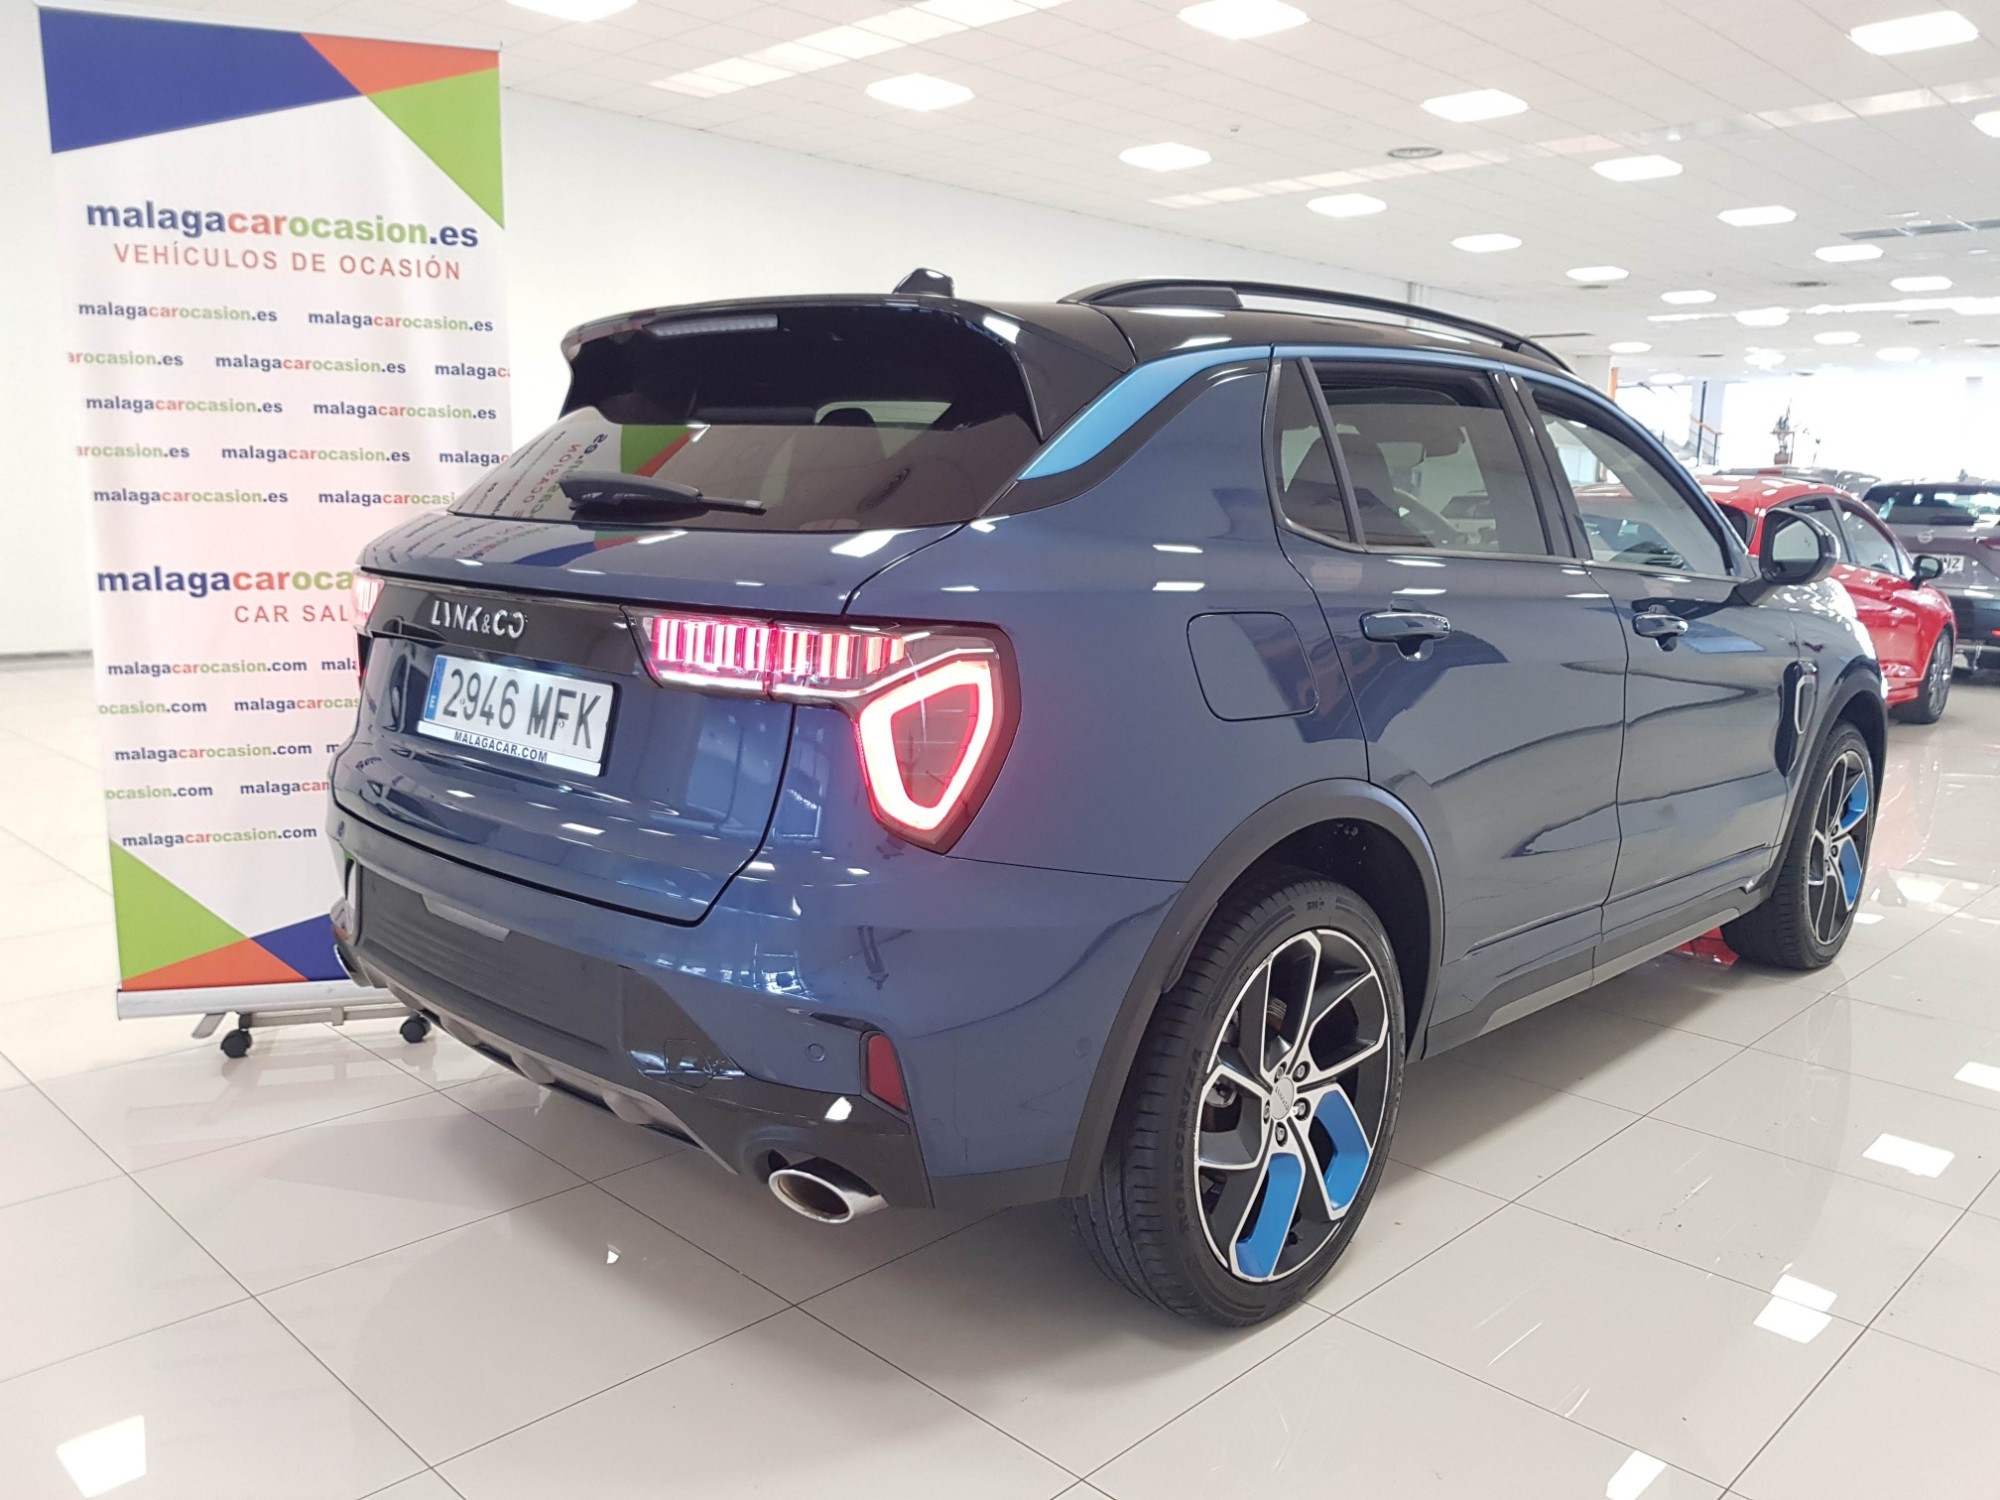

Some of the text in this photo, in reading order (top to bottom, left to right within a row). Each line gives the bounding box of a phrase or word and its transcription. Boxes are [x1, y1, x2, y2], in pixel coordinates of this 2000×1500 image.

[87, 200, 479, 248] malagacarocasion.es
[114, 241, 460, 280] VEHÍCULOS DE OCASIÓN
[78, 301, 278, 322] malagacarocasion.es
[308, 310, 494, 333] malagacarocasion.es
[215, 353, 407, 374] malagacarocasion.es
[86, 395, 284, 414] malagacarocasion.es
[313, 401, 497, 420] malagacarocasion.es
[221, 444, 411, 464] malagacarocasion.es
[94, 487, 289, 506] malagacarocasion.es
[235, 605, 289, 623] CAR
[108, 659, 308, 677] malagacarocasion.com
[98, 700, 208, 715] ocasion.com
[442, 668, 520, 730] 2946
[526, 683, 602, 750] MFK
[115, 744, 313, 763] malagacarocasion.com
[453, 730, 549, 763] MALAGACAR.COM
[105, 785, 214, 800] ocasion.com
[122, 827, 318, 847] malagacarocasion.com
